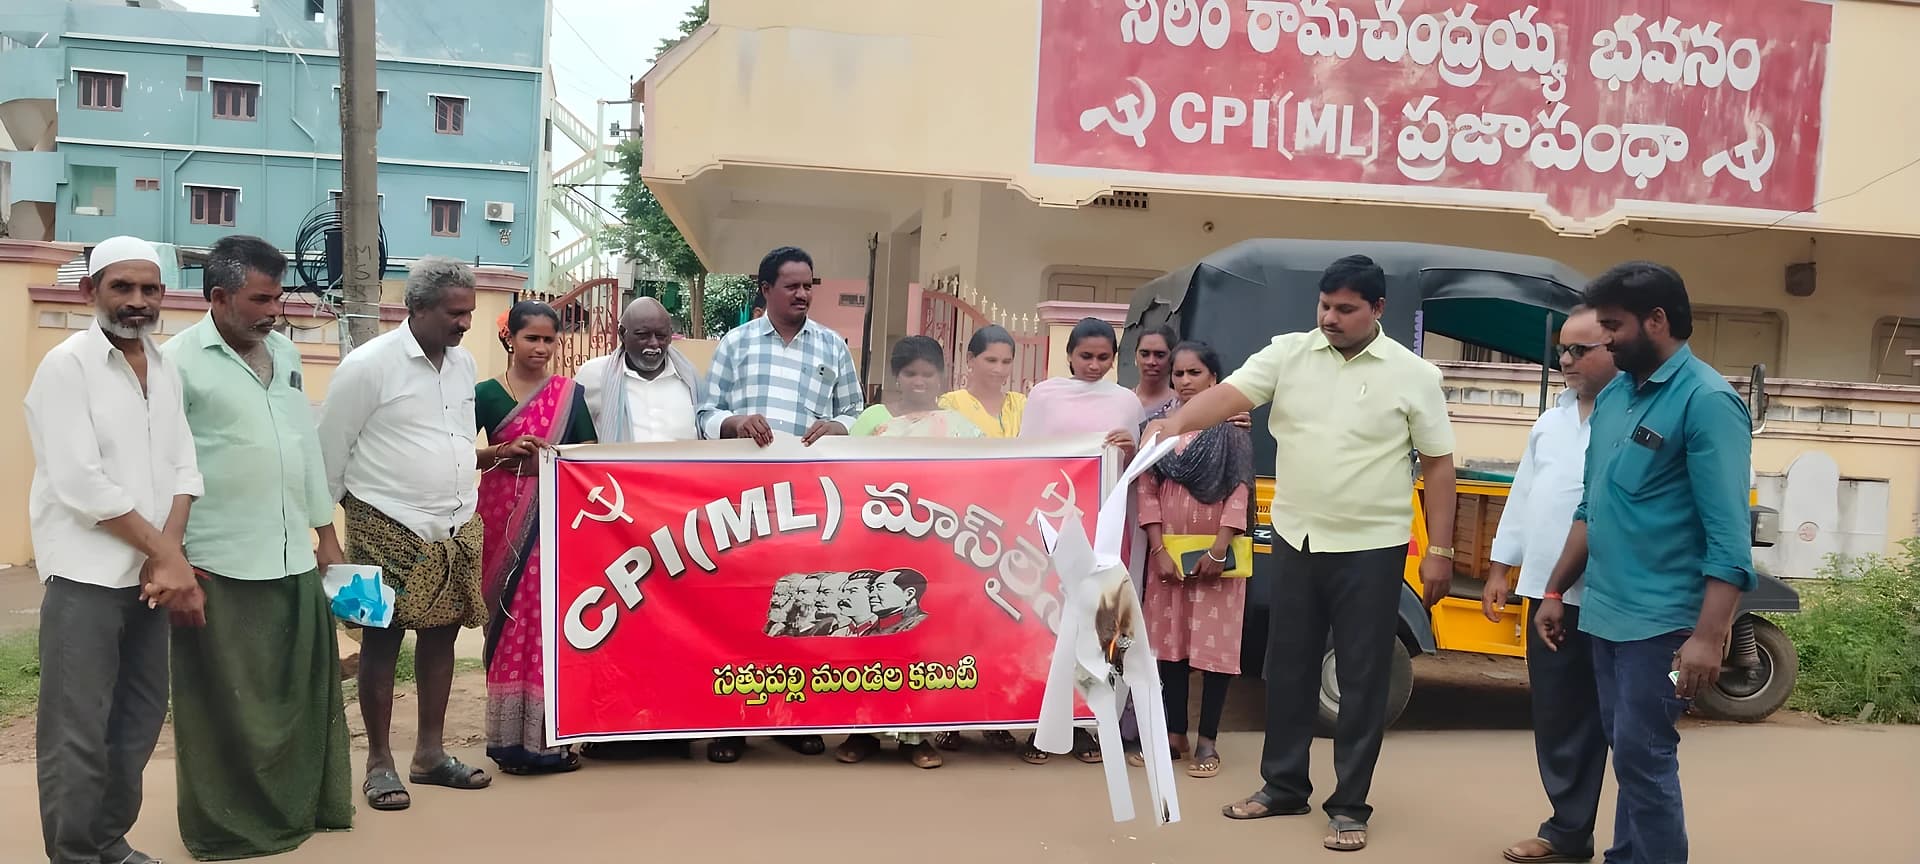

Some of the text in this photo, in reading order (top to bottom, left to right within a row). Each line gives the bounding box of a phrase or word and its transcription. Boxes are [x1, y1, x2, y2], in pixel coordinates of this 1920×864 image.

[1590, 13, 1760, 91] భవనం
[1169, 91, 1379, 165] CPI(ML)
[563, 476, 842, 649] CPI(ML)
[712, 662, 807, 705] సత్తుపల్లి
[810, 661, 903, 693] మండల
